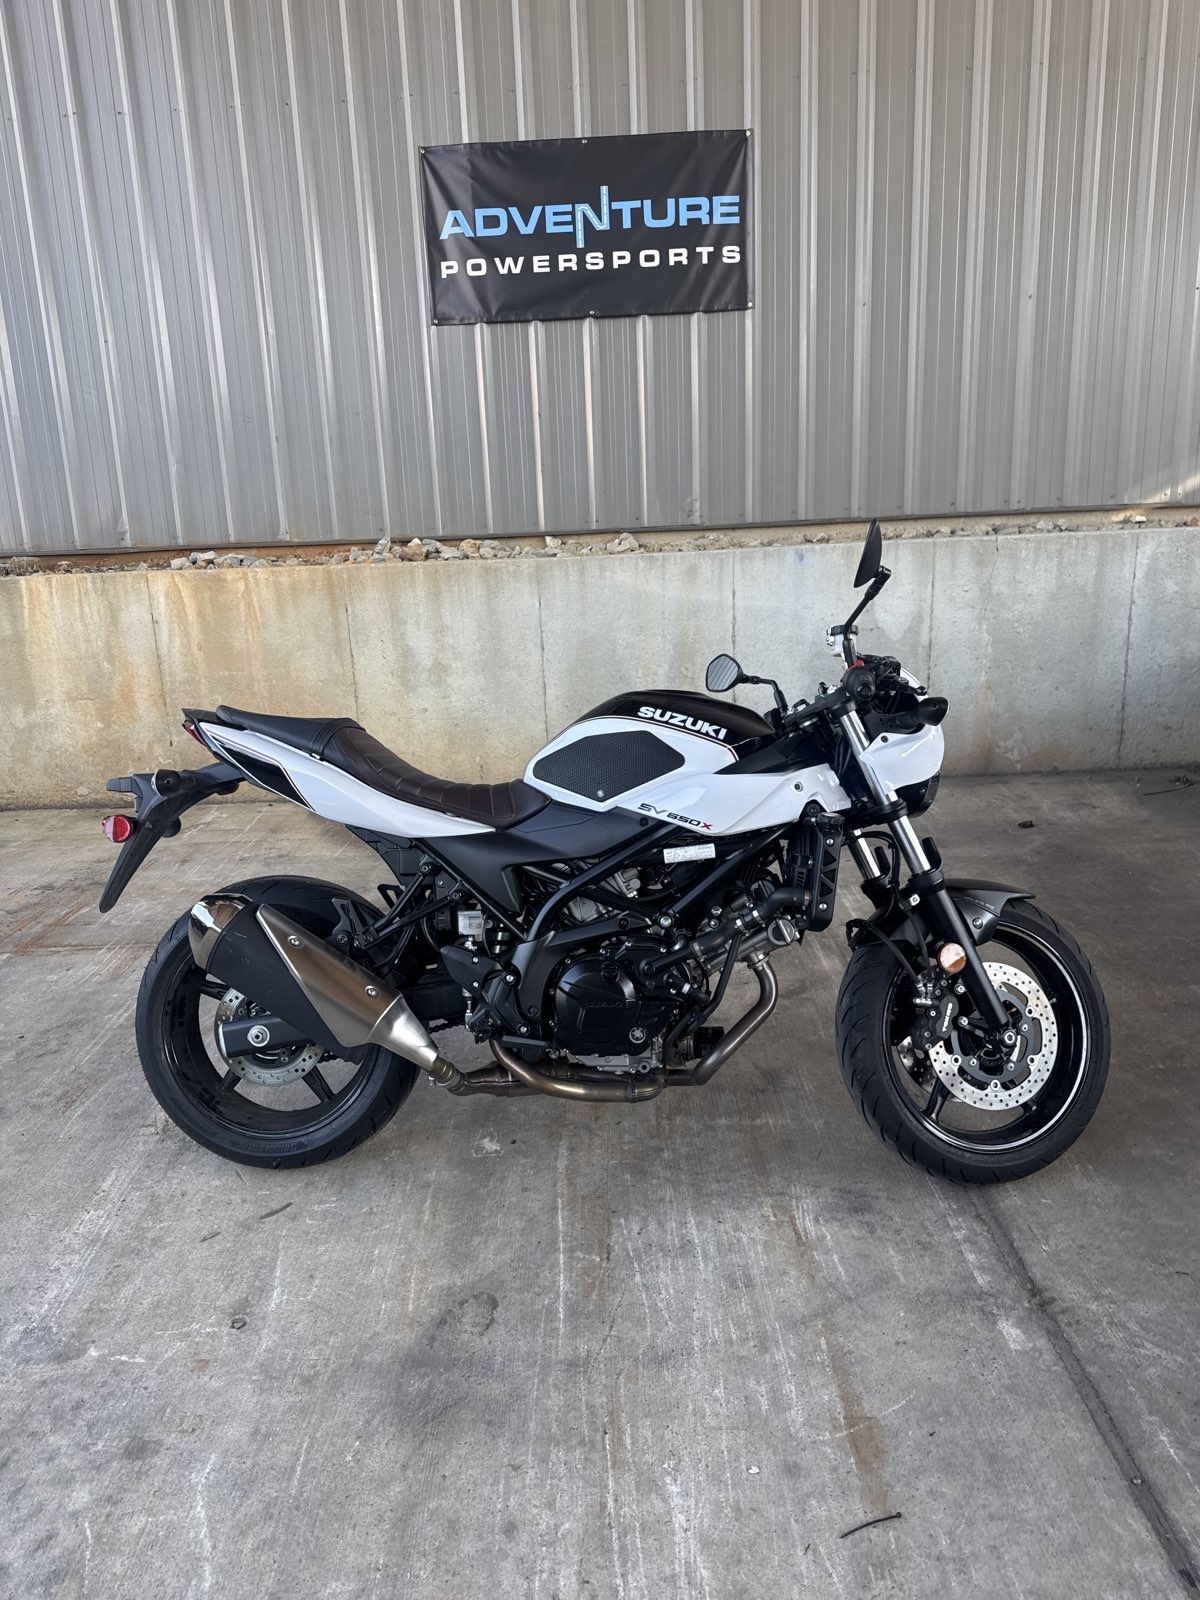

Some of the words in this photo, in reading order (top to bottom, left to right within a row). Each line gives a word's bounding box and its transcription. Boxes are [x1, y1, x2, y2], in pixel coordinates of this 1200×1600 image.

[439, 185, 740, 248] ADVENTURE
[440, 245, 740, 278] POWERSPORTS
[637, 706, 728, 740] SUZUKI
